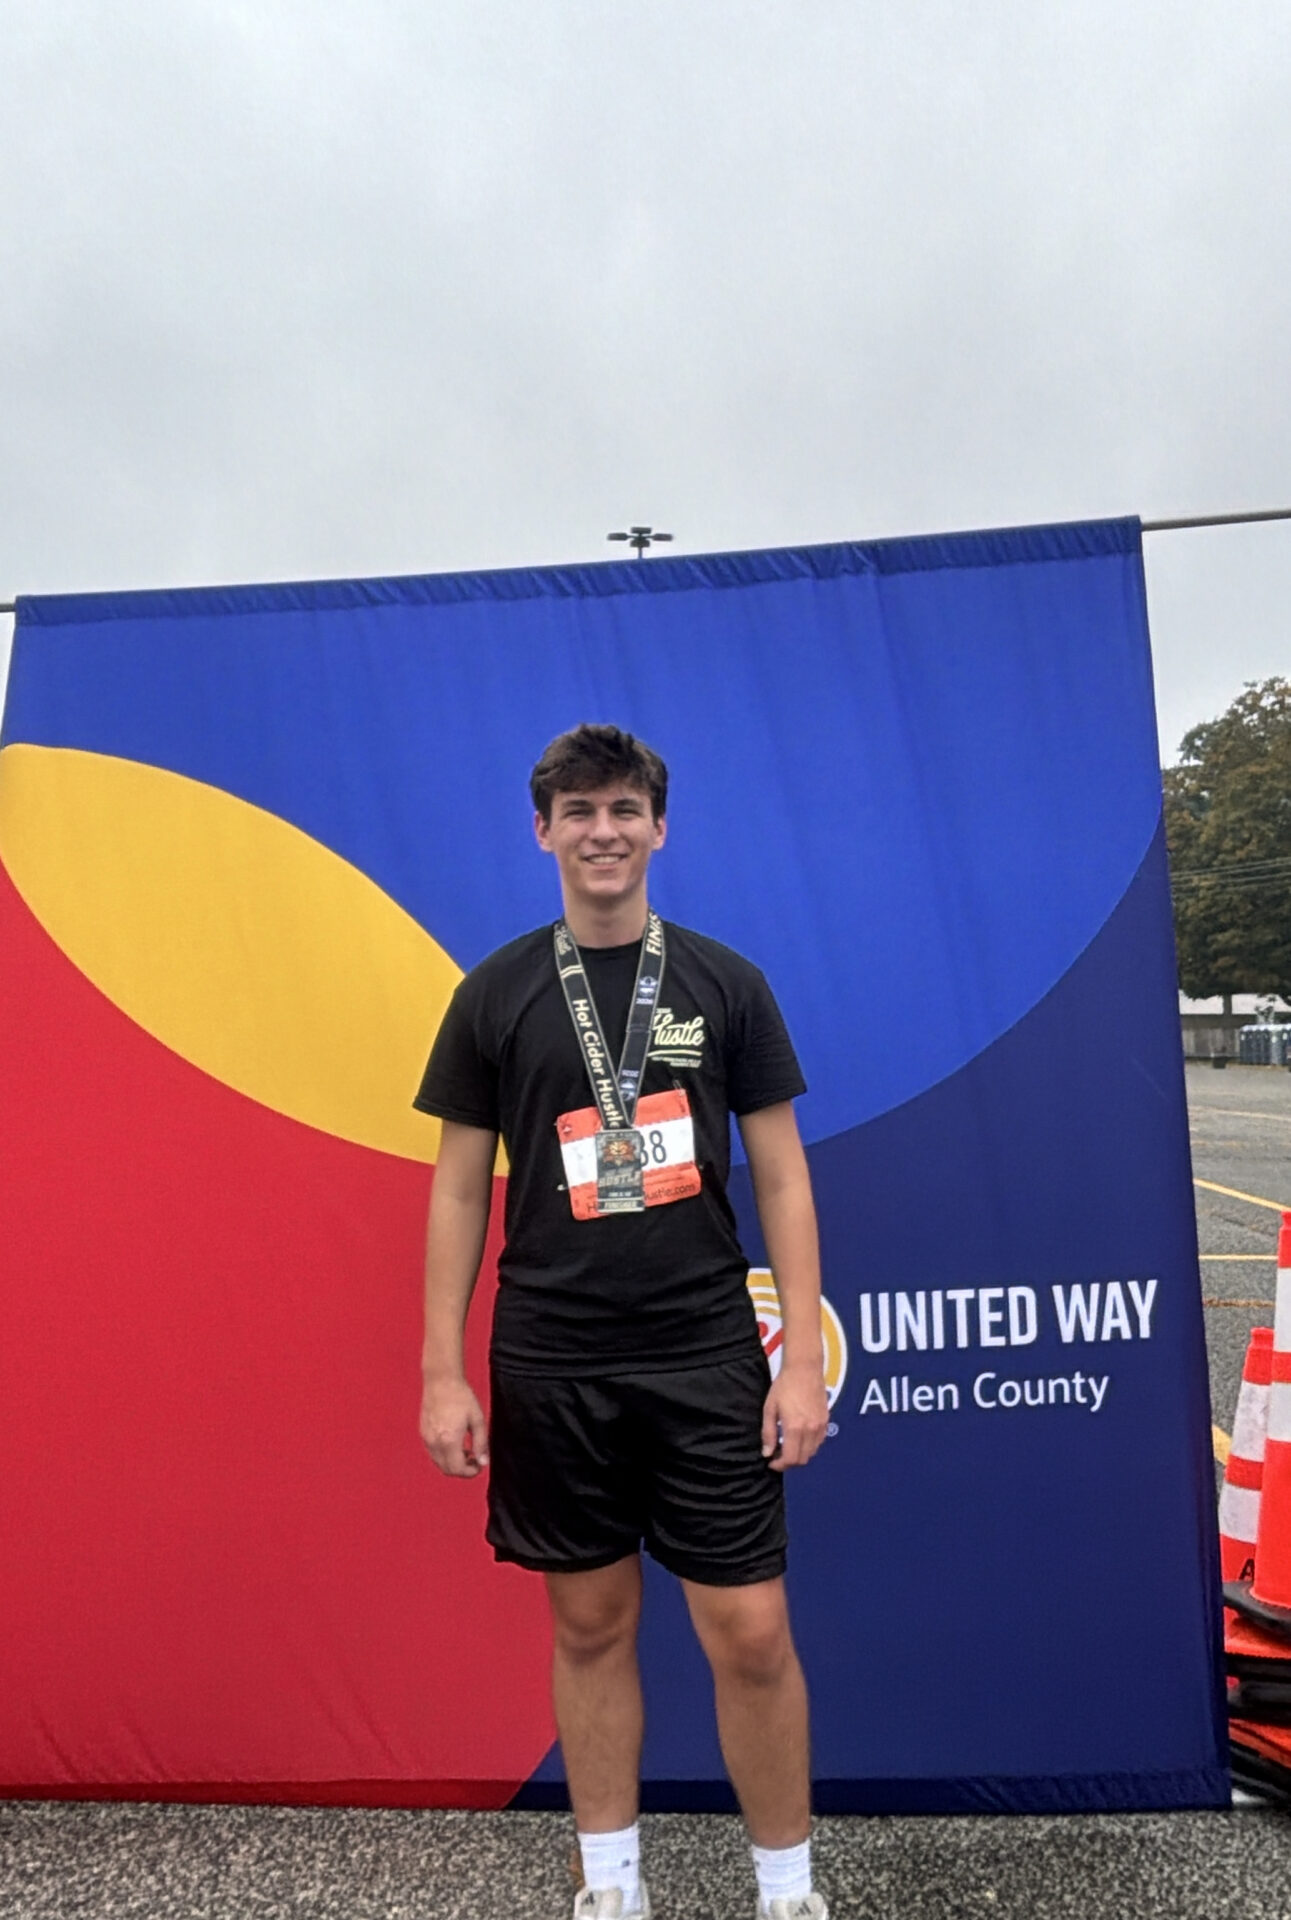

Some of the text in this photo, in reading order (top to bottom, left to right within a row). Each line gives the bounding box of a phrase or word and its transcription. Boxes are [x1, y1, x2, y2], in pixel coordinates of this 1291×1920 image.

[572, 999, 624, 1128] Hot Cider Hustle
[860, 1279, 1158, 1353] UNITED WAY
[859, 1371, 1109, 1415] Allen County
